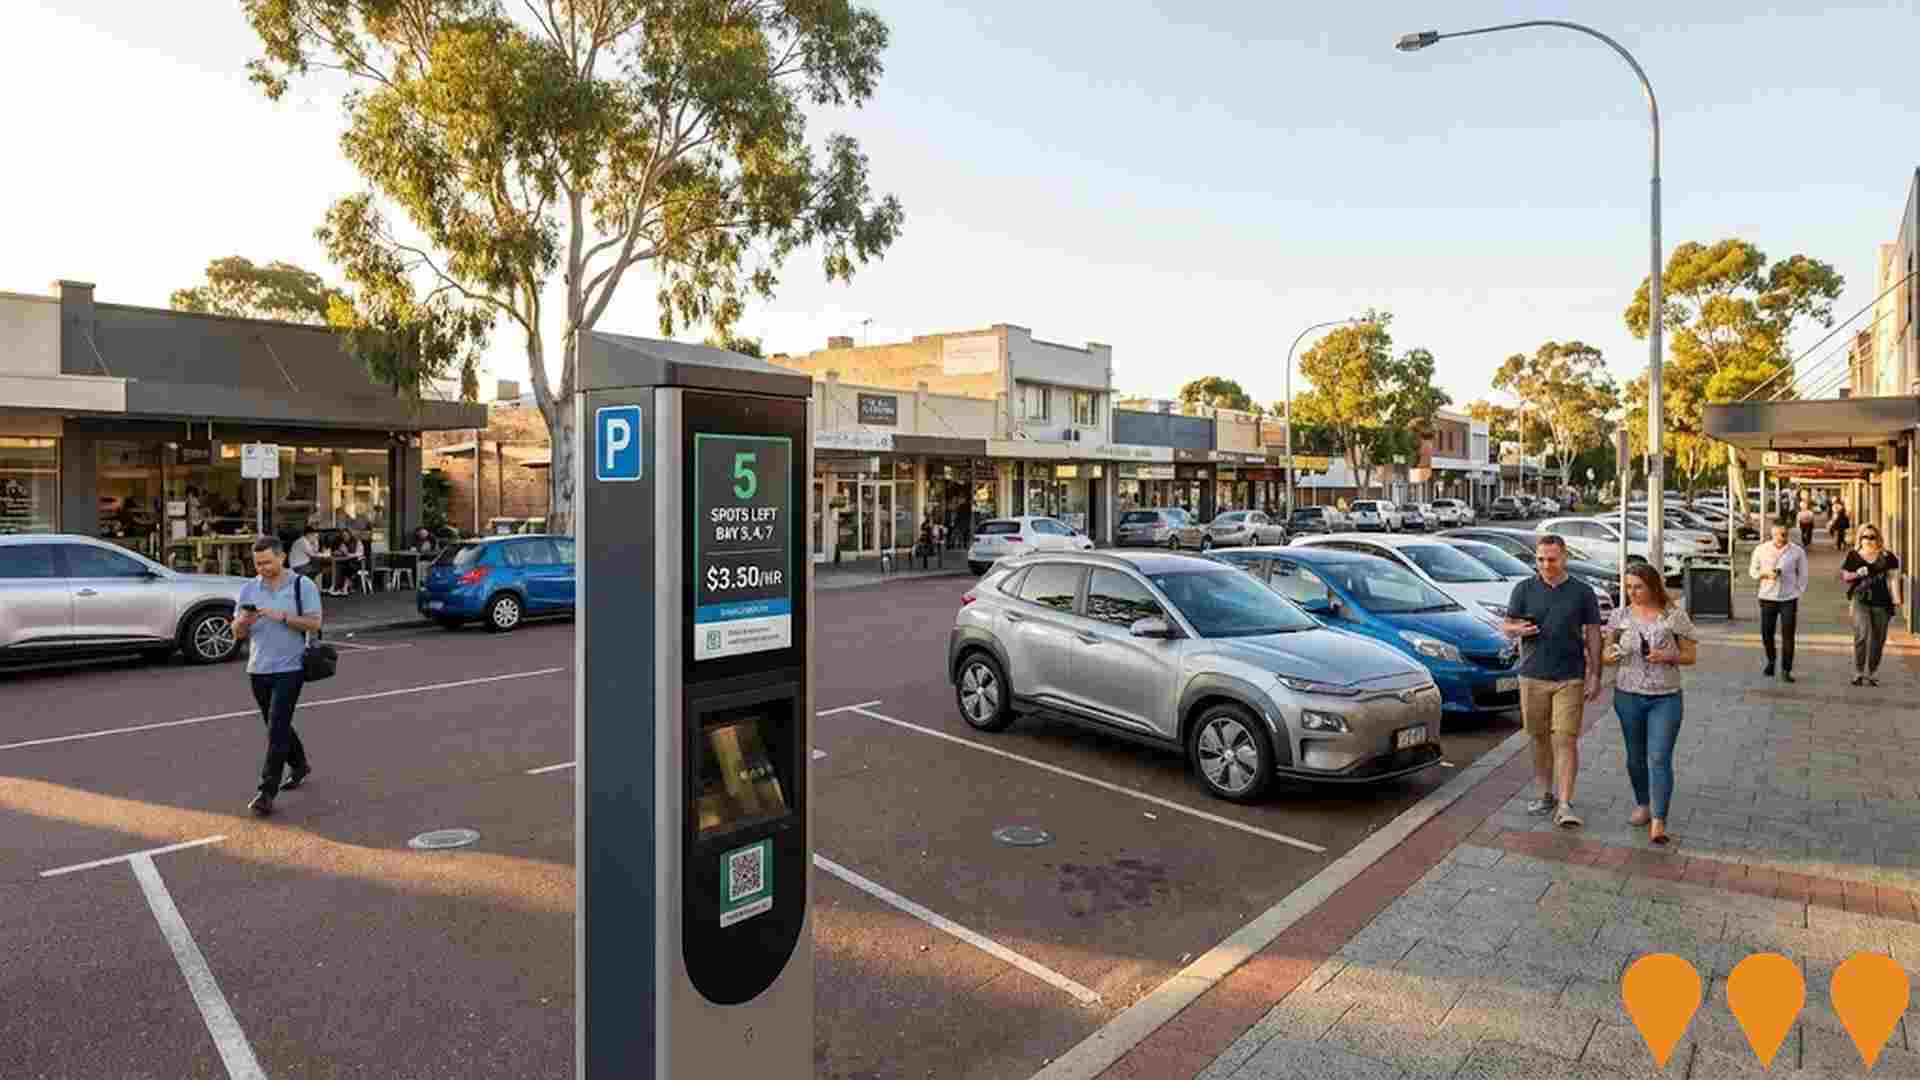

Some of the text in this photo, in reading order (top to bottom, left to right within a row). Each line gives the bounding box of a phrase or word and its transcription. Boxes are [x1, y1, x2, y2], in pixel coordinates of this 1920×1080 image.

[607, 418, 631, 469] P
[733, 451, 758, 500] 5
[711, 507, 777, 522] SPOTS LEFT
[765, 525, 774, 540] 7
[706, 564, 783, 592] $3.50/HR
